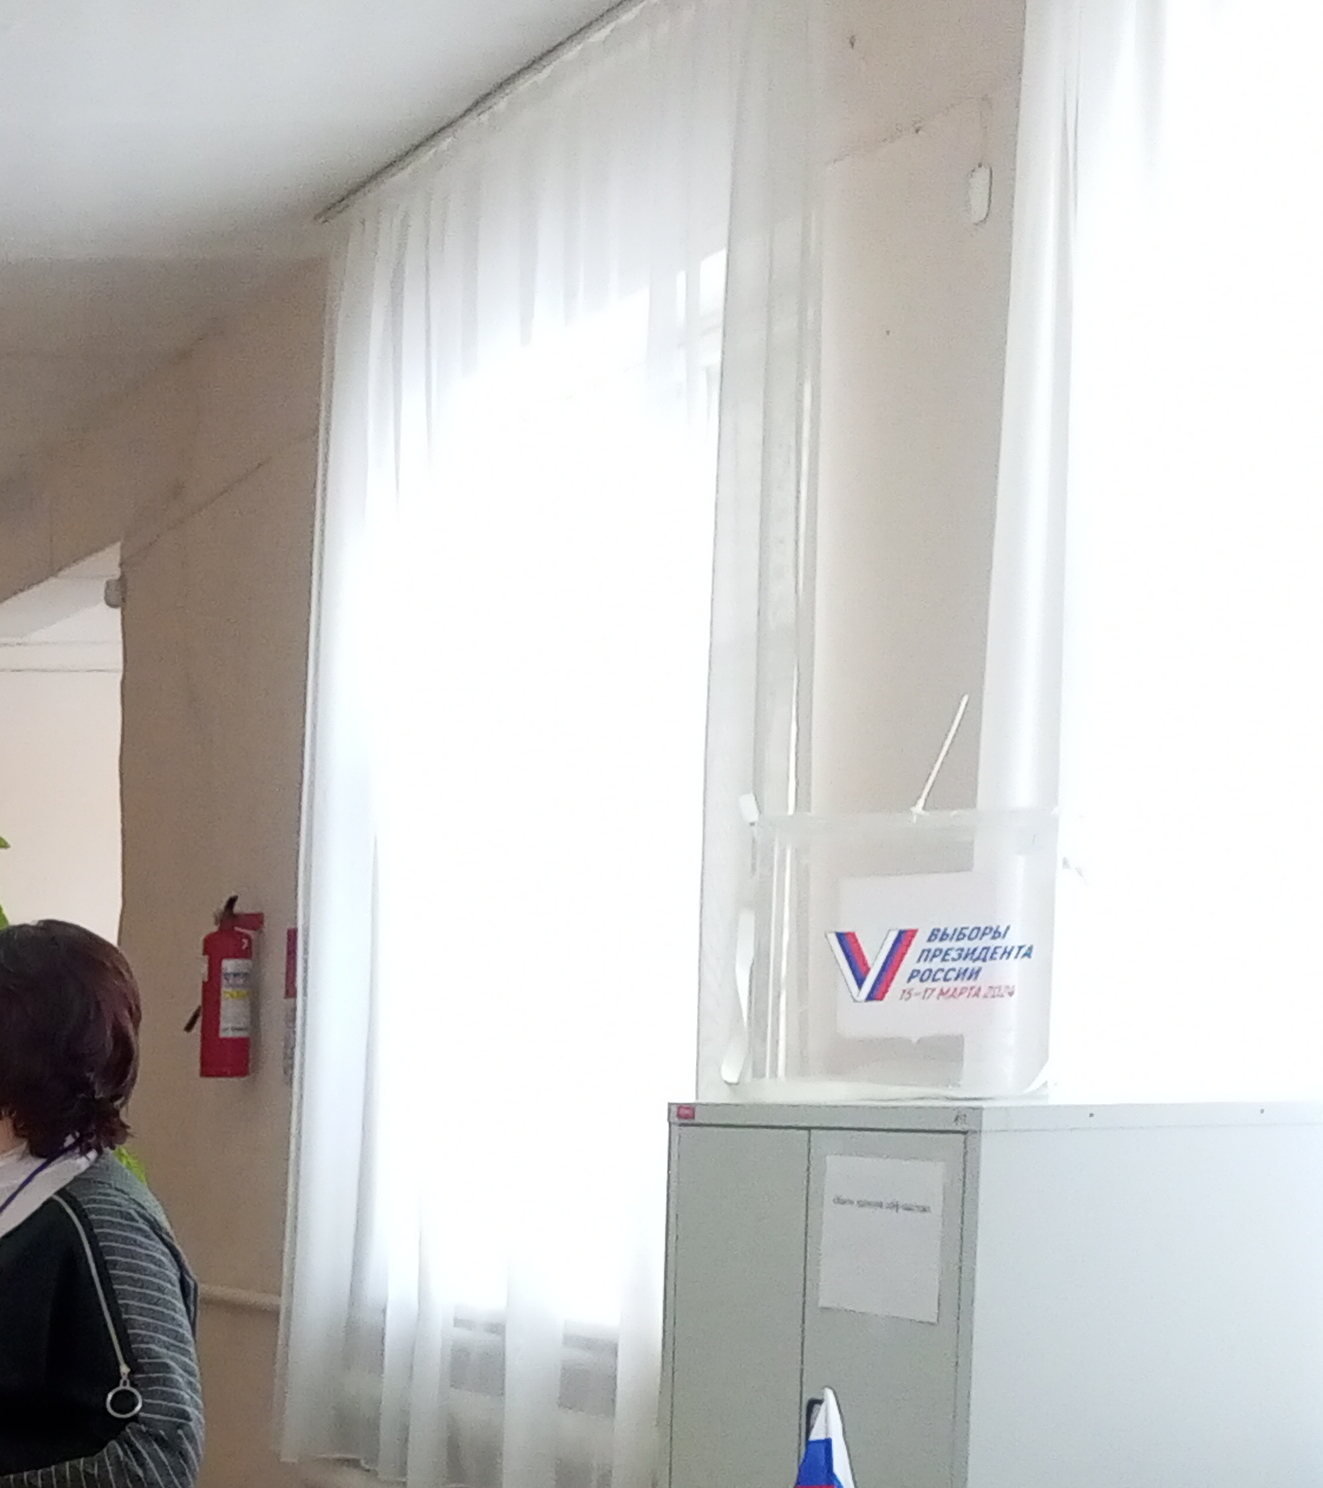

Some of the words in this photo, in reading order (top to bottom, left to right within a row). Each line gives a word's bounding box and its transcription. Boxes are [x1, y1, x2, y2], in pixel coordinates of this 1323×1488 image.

[926, 925, 1010, 943] ВЫБОРЫ
[916, 944, 1034, 964] ПРЕЗИДЕНТА
[906, 966, 983, 984] РОССИИ
[936, 985, 982, 1000] МАРТА
